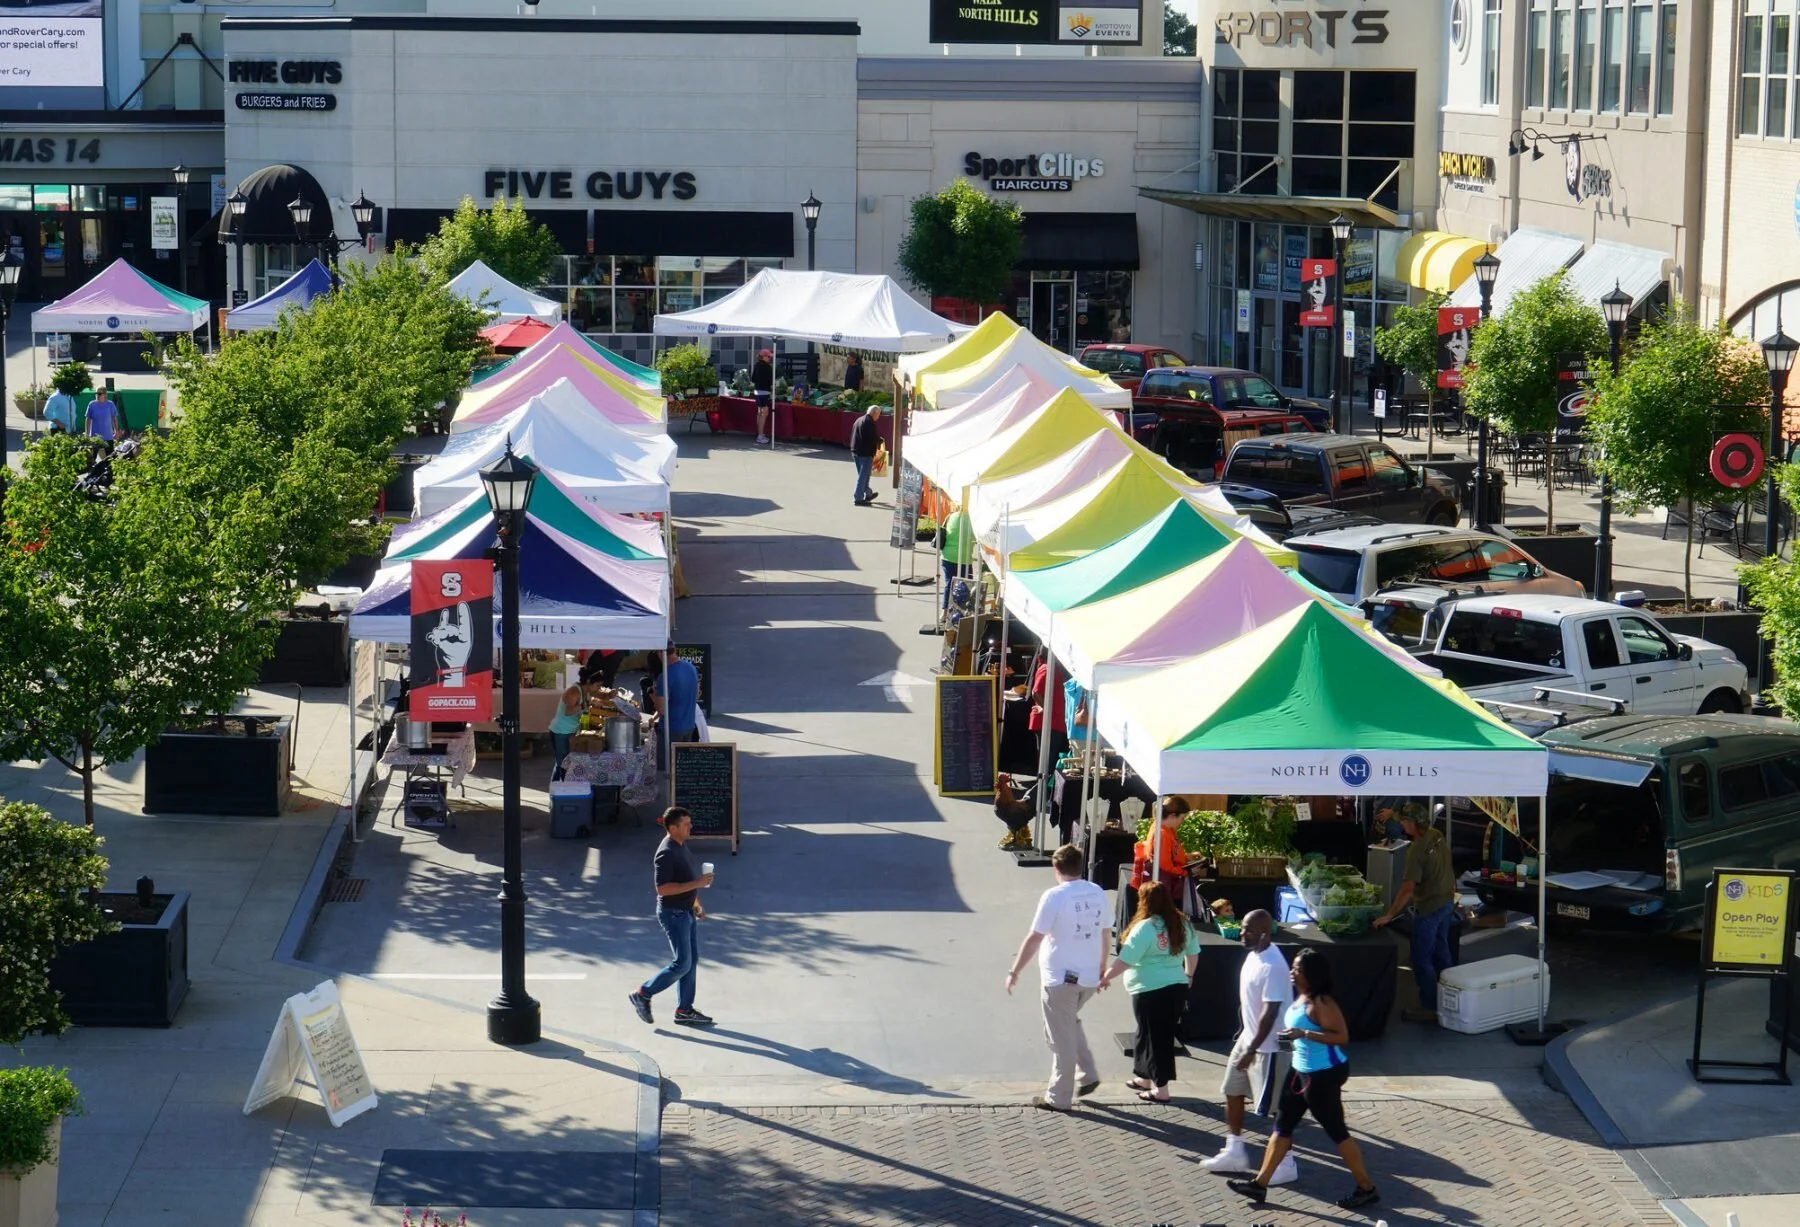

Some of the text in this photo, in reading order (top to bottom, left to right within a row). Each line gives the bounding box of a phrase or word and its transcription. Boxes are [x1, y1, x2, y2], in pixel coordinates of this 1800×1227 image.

[959, 8, 1039, 25] NORTH HILLS
[1215, 10, 1390, 49] SPORTS
[13, 41, 46, 50] special
[47, 40, 78, 49] offers!
[12, 67, 31, 77] Cary
[228, 61, 342, 84] FIVE GUYS
[241, 95, 326, 108] BURGERS and FRIES
[66, 138, 101, 164] 14
[485, 171, 698, 200] FIVE GUYS
[995, 180, 1069, 190] HAIRCUTS
[530, 624, 577, 634] HILLS
[1271, 765, 1329, 777] NORTH
[1383, 766, 1439, 777] HILLS
[1747, 883, 1784, 898] KIDS
[1722, 912, 1779, 925] Open Play
